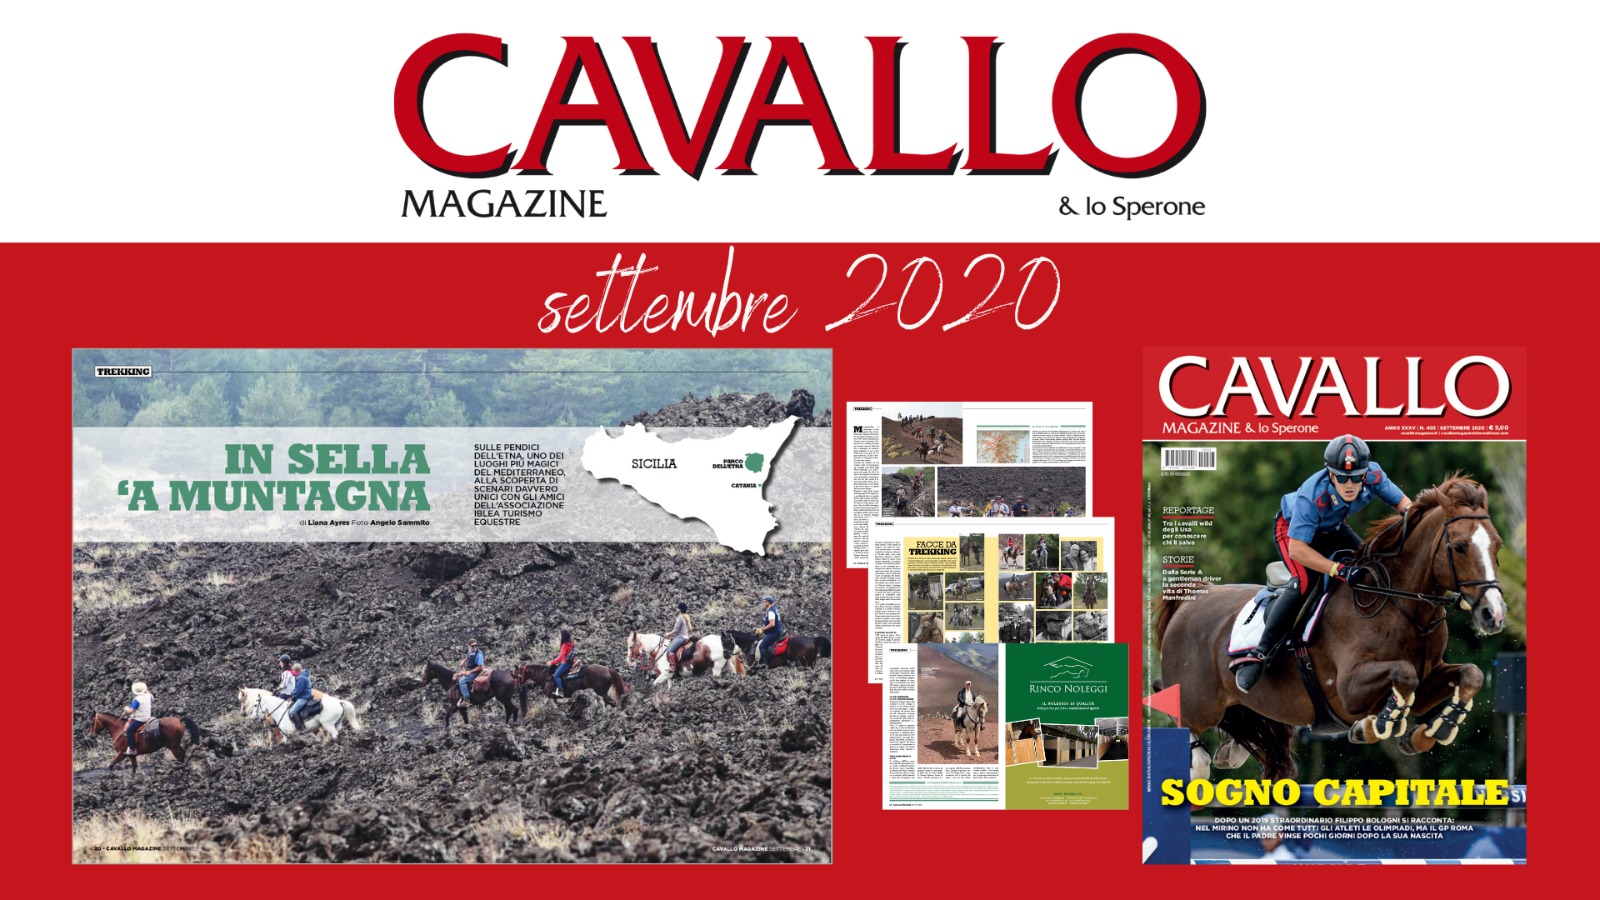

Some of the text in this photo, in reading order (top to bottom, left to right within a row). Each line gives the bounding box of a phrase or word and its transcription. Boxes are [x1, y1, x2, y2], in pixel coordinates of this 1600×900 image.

[394, 33, 1206, 181] CAVALLO
[402, 189, 607, 218] MAGAZINE
[1059, 196, 1205, 220] & lo Sperone
[1159, 356, 1510, 418] CAVALLO
[1162, 422, 1318, 435] MAGAZINE & lo Sperone
[225, 443, 430, 474] IN SELLA
[510, 458, 524, 467] PIÙ
[632, 459, 677, 468] SICILIA
[170, 480, 430, 512] MUNTAGNA
[1030, 685, 1107, 693] RINCO NOLEGGI
[1162, 778, 1300, 807] SOGNO
[1314, 778, 1508, 807] CAPITALE
